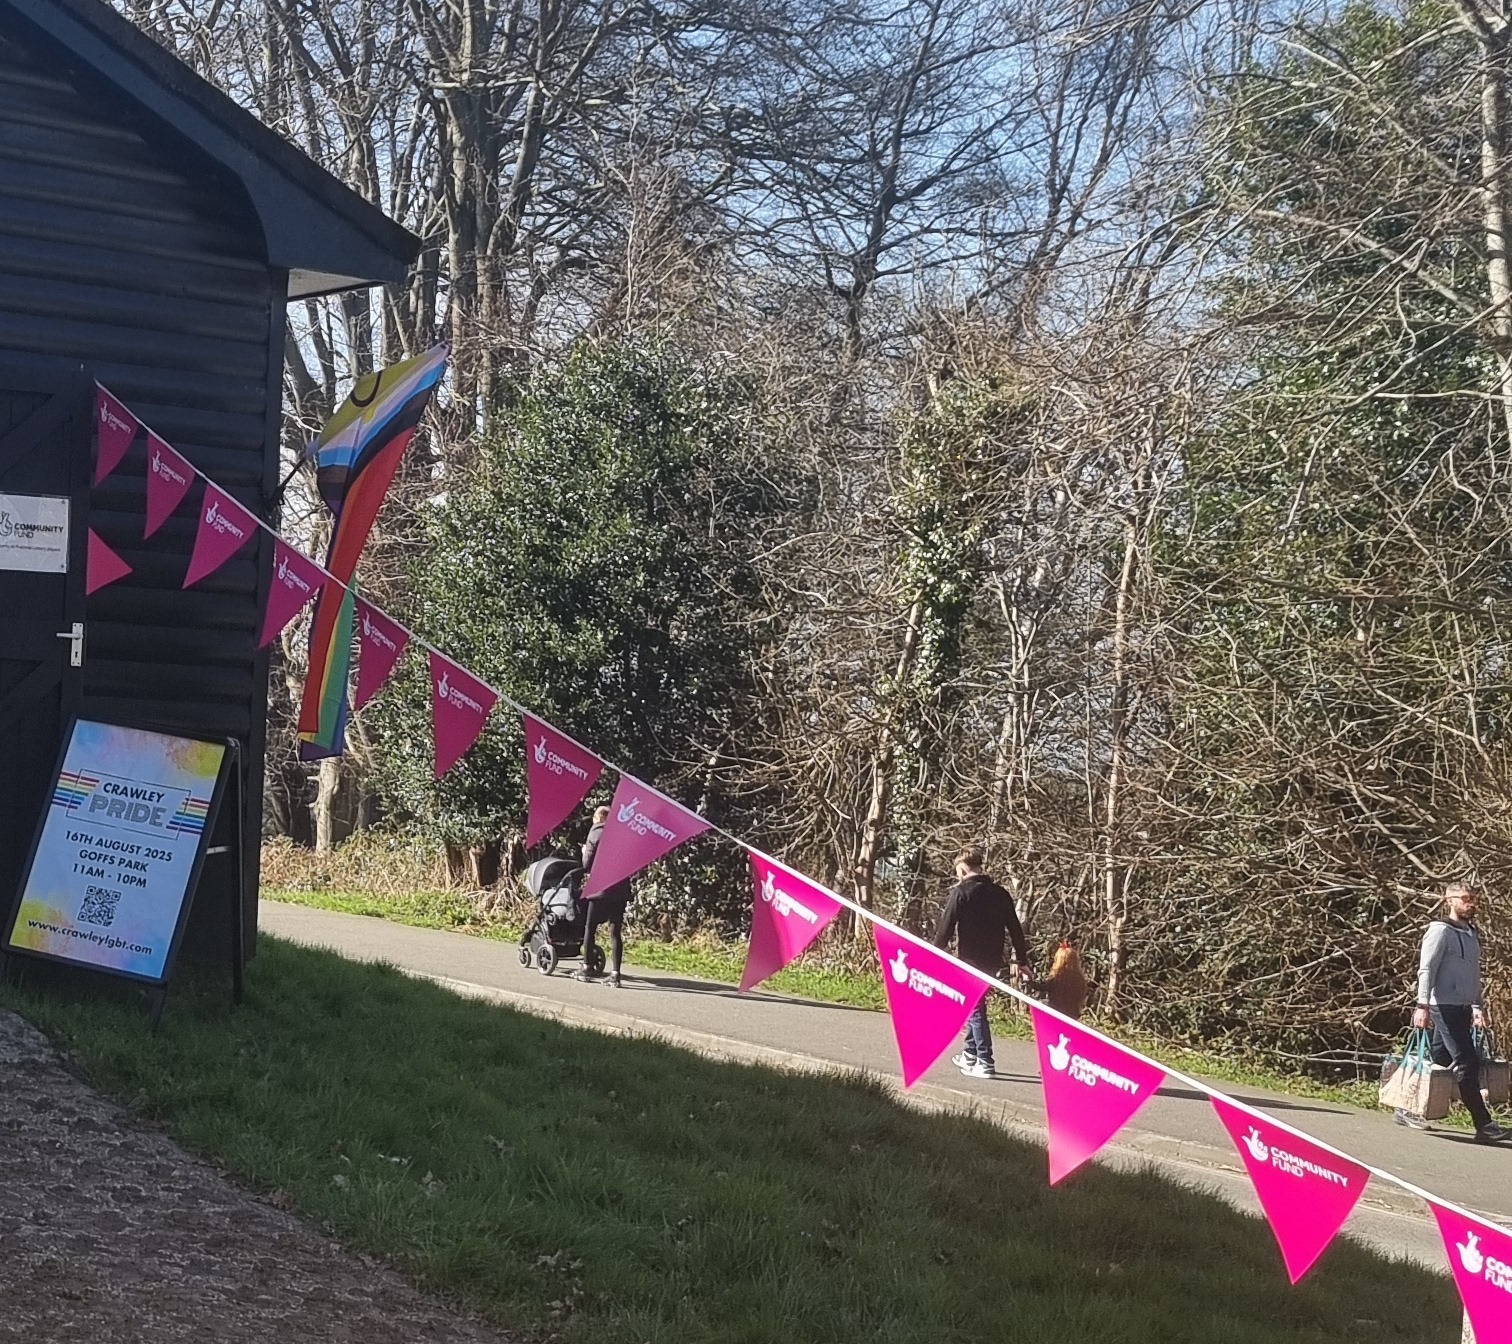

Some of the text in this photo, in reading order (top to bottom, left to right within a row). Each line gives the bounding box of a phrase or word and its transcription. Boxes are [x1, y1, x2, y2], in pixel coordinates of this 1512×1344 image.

[13, 530, 34, 539] FUND
[14, 522, 64, 533] COMMUNITY
[449, 686, 483, 714] COMMUNITY
[544, 759, 563, 775] FUND
[547, 751, 588, 780] COMMUNITY
[103, 782, 165, 803] CRAWLEY
[88, 794, 167, 828] PRIDE
[627, 820, 647, 836] FUND
[634, 813, 677, 843] COMMUNITY
[65, 830, 173, 862] 16TH AUGUST 2025
[79, 849, 149, 873] GOFFS PARK
[72, 862, 105, 879] 11AM
[117, 872, 147, 888] 10PM
[771, 898, 790, 917] FUND
[775, 888, 819, 925] COMMUNITY
[27, 918, 152, 955] www.crawleylgbt.com
[908, 978, 933, 998] FUND
[909, 968, 966, 1006] COMMUNITY
[1068, 1065, 1096, 1087] FUND
[1071, 1054, 1140, 1095] COMMUNITY
[1270, 1146, 1348, 1187] COMMUNITY
[1271, 1156, 1304, 1178] FUND
